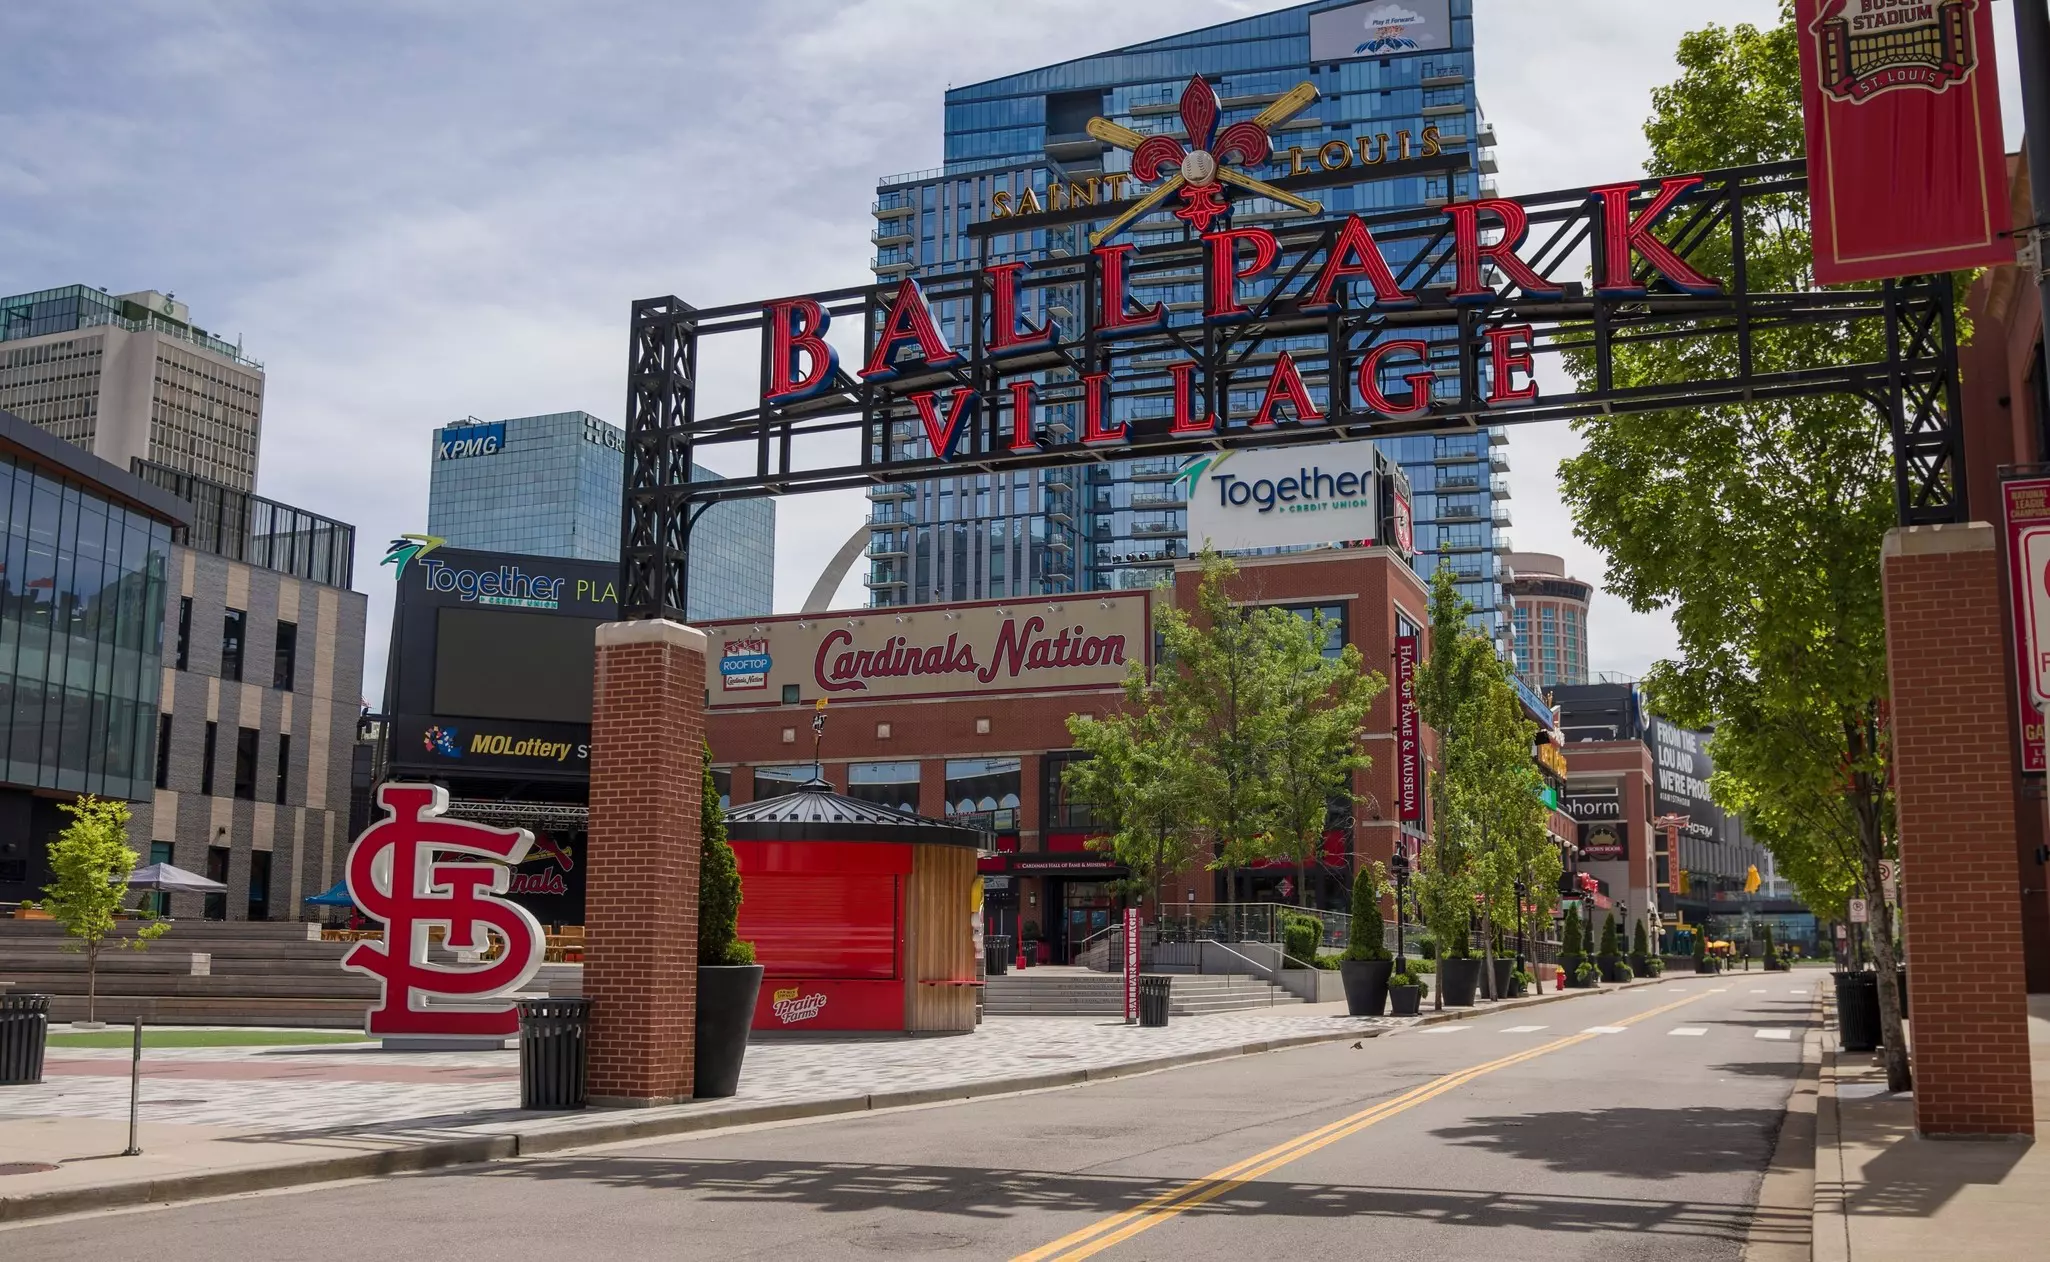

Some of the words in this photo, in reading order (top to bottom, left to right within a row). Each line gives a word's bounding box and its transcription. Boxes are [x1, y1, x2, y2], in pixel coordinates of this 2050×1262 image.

[1853, 4, 1933, 30] STADIUM
[1860, 76, 1883, 93] ST.
[1887, 69, 1937, 83] LOUIS
[991, 172, 1132, 220] SAINT
[1288, 126, 1441, 177] LOUIS
[762, 173, 1724, 403] BALLPARK
[908, 323, 1540, 463] VILLAGE
[437, 435, 498, 461] KPMG
[1211, 466, 1372, 513] Together
[2011, 487, 2048, 500] NATIONAL
[2015, 497, 2046, 510] LEAGUE
[1288, 502, 1327, 513] CREDIT
[1332, 499, 1368, 510] UNION
[418, 558, 565, 602] Together
[488, 597, 523, 606] CREDIT
[526, 600, 558, 608] UNION
[723, 659, 767, 670] ROOFTOP
[813, 629, 979, 693] Cardinals
[977, 615, 1129, 684] Nation
[1400, 644, 1412, 680] HALL
[1401, 681, 1413, 699] OF
[1402, 702, 1413, 737] FAME
[470, 734, 572, 762] MOLottery
[1402, 739, 1415, 751] &
[1657, 721, 1682, 749] FROM
[1681, 730, 1697, 754] THE
[1658, 744, 1676, 769] LOU
[1676, 752, 1694, 775] AND
[1403, 753, 1415, 813] MUSEUM
[1659, 768, 1686, 796] WE'RE
[1129, 911, 1137, 956] VILLAGE
[1129, 962, 1137, 1013] BALLPARK
[773, 993, 826, 1016] Prairie
[781, 1008, 819, 1024] Farms
